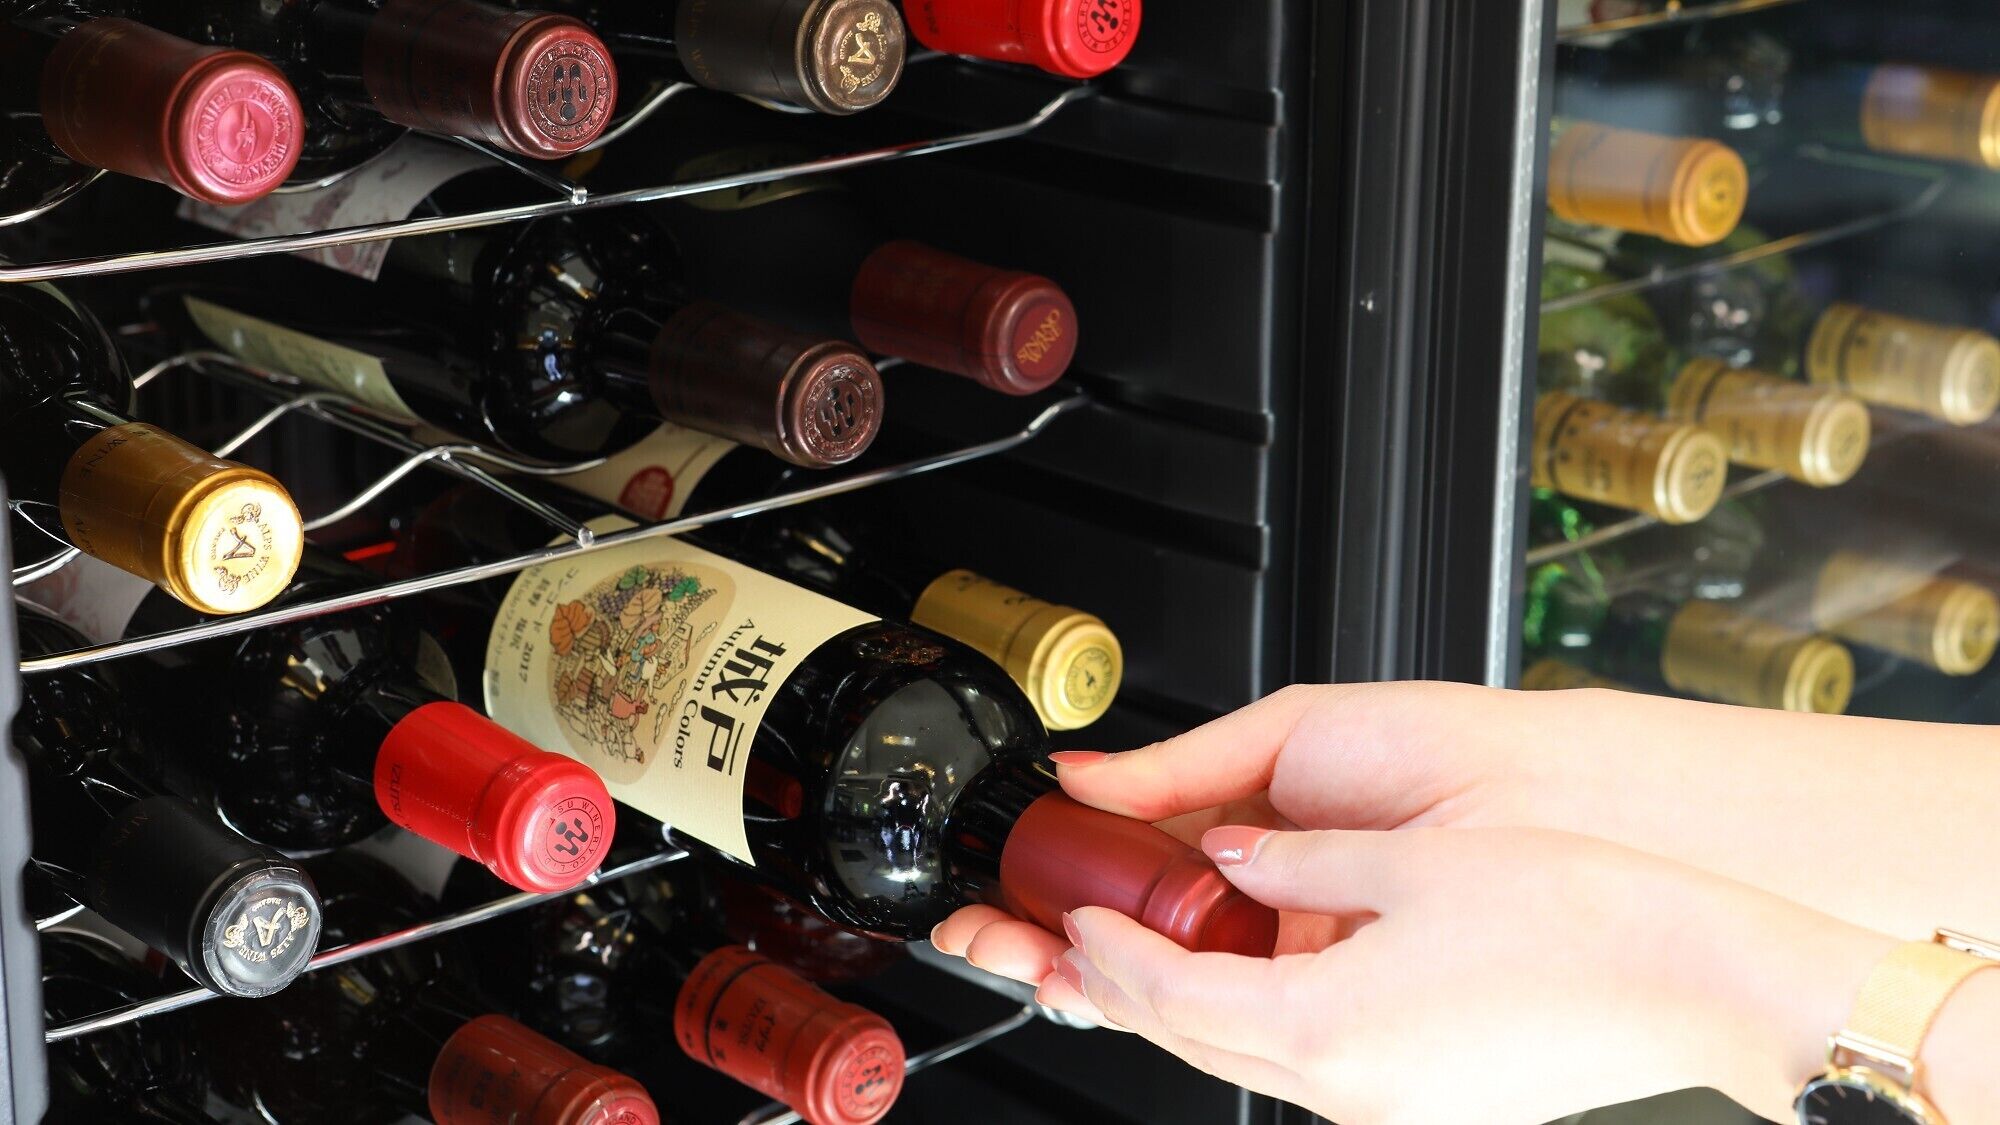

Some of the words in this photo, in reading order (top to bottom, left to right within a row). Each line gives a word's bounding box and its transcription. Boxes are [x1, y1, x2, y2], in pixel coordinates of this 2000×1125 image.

[259, 523, 273, 551] ALPS
[243, 555, 271, 584] WINE
[518, 641, 535, 684] 2017
[693, 618, 756, 693] Autumn
[700, 634, 788, 777] 城戸
[673, 699, 700, 769] Colors
[582, 801, 601, 856] WINERY
